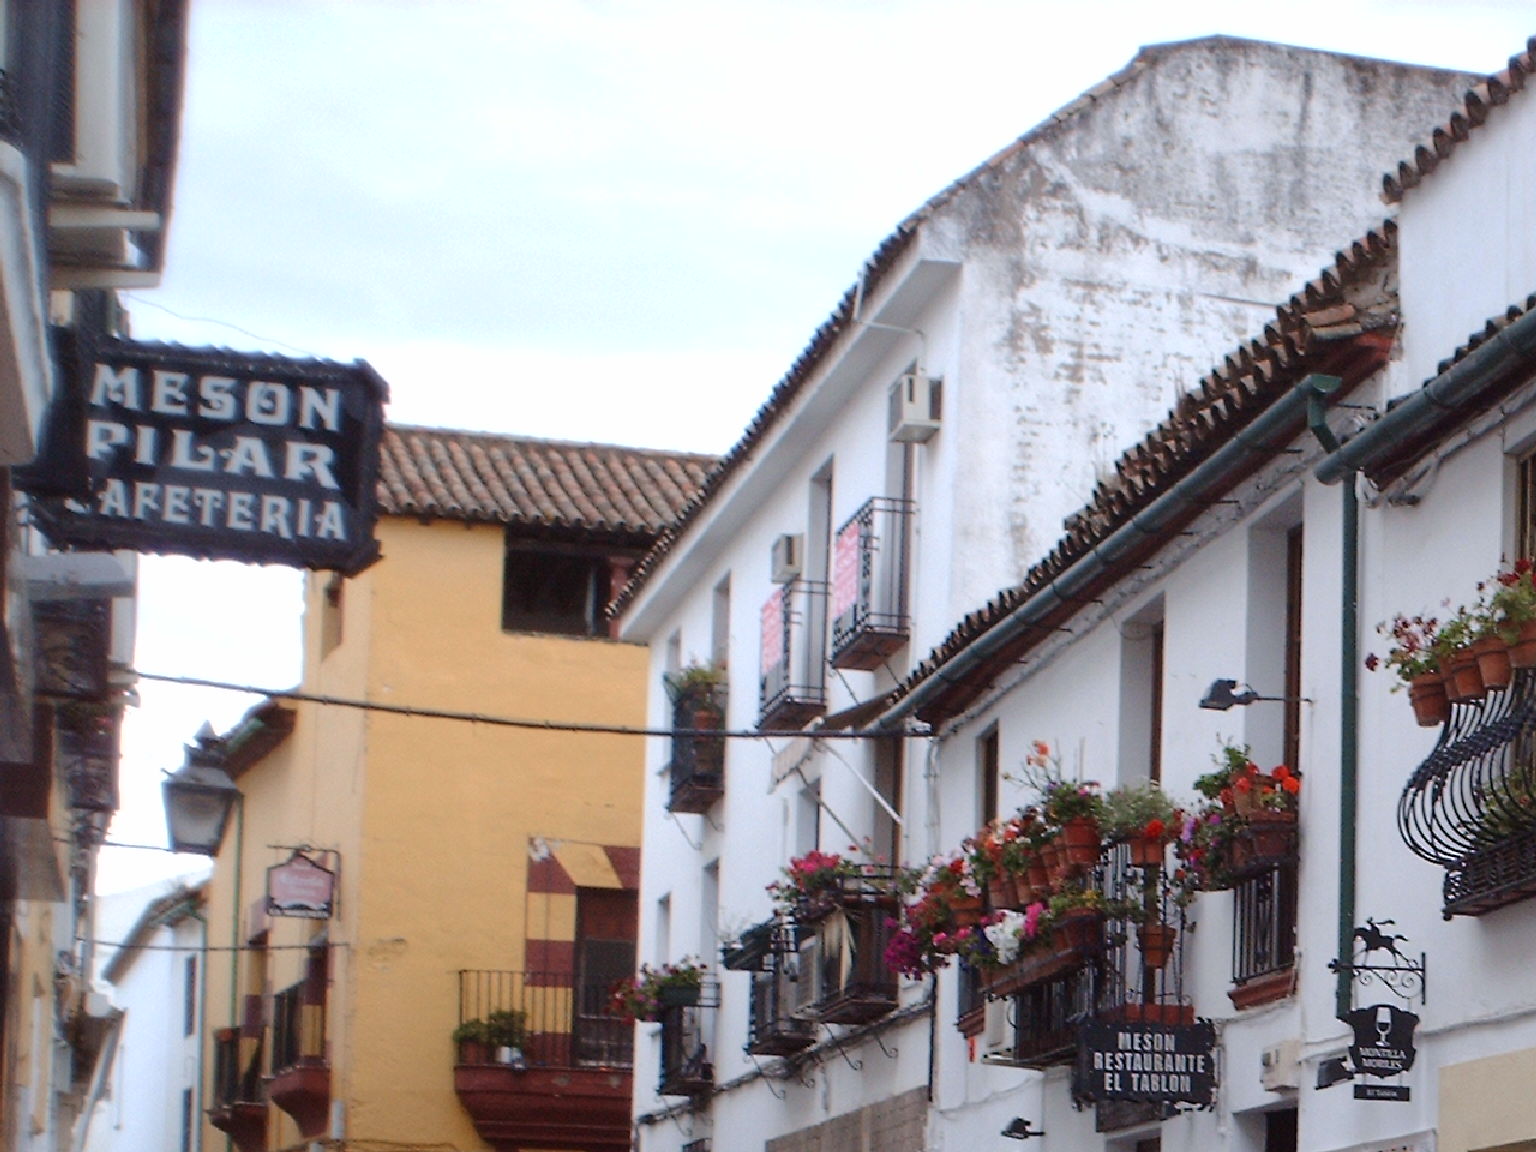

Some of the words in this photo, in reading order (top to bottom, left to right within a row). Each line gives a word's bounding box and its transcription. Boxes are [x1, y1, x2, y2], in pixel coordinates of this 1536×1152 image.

[88, 362, 342, 431] MESON
[85, 418, 341, 491] PILAR
[64, 478, 348, 541] AFETERIA
[1094, 1052, 1205, 1073] RESTAURANTE
[1118, 1031, 1175, 1052] MESON
[1104, 1072, 1122, 1091] EL
[1131, 1072, 1191, 1092] TABLON
